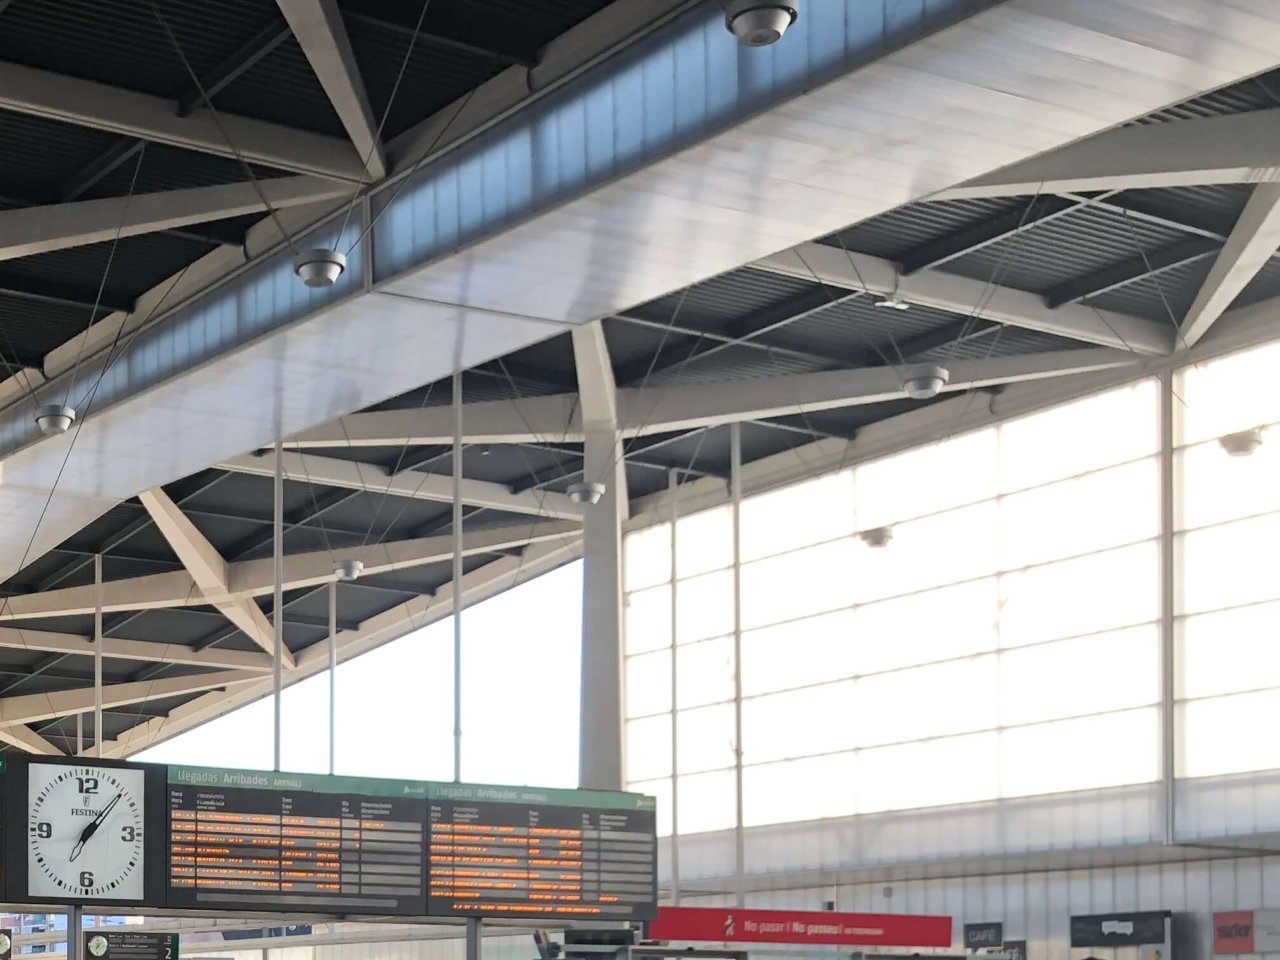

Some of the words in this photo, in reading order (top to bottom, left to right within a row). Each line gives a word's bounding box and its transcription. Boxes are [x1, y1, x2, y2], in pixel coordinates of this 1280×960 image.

[76, 777, 99, 794] 12
[178, 770, 218, 784] Llegadas
[223, 773, 268, 786] Arribades
[71, 808, 104, 817] FESTINA
[37, 822, 52, 839] 9
[121, 826, 135, 842] 3
[79, 871, 94, 888] 6
[744, 920, 757, 932] No
[759, 922, 784, 934] pasar
[792, 922, 805, 933] No
[165, 947, 172, 960] 2
